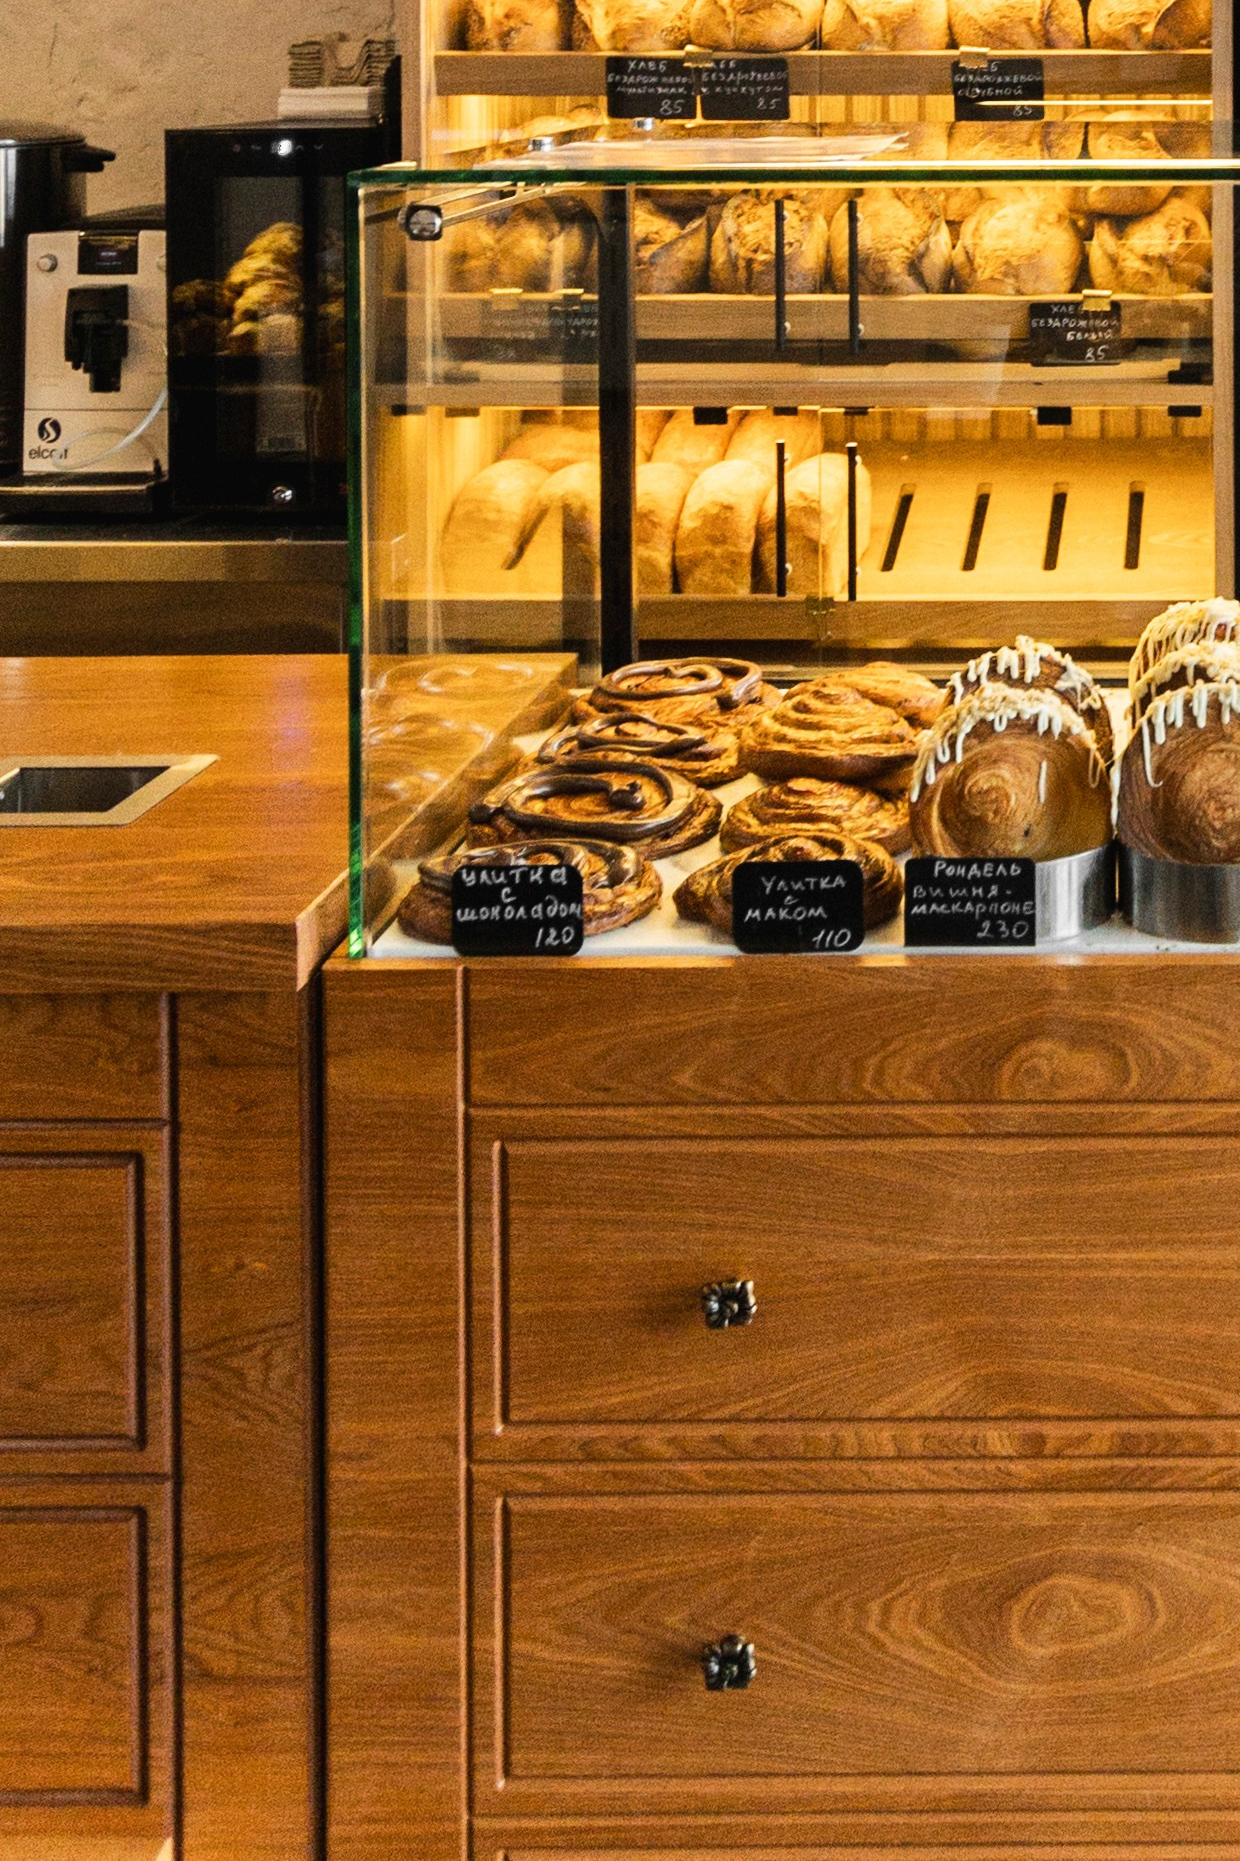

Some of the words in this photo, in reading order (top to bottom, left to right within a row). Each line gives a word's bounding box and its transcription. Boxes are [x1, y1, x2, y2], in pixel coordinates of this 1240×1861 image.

[659, 99, 686, 116] 85
[1085, 345, 1109, 363] 85
[933, 860, 1022, 880] РОНДЕЛЬ
[761, 874, 847, 895] УЛИТКА
[743, 906, 828, 923] МАКОМ
[910, 900, 1035, 920] МАСКАРПОНЕ
[535, 925, 575, 948] 120
[812, 928, 852, 948] 110
[976, 920, 1029, 938] 230
